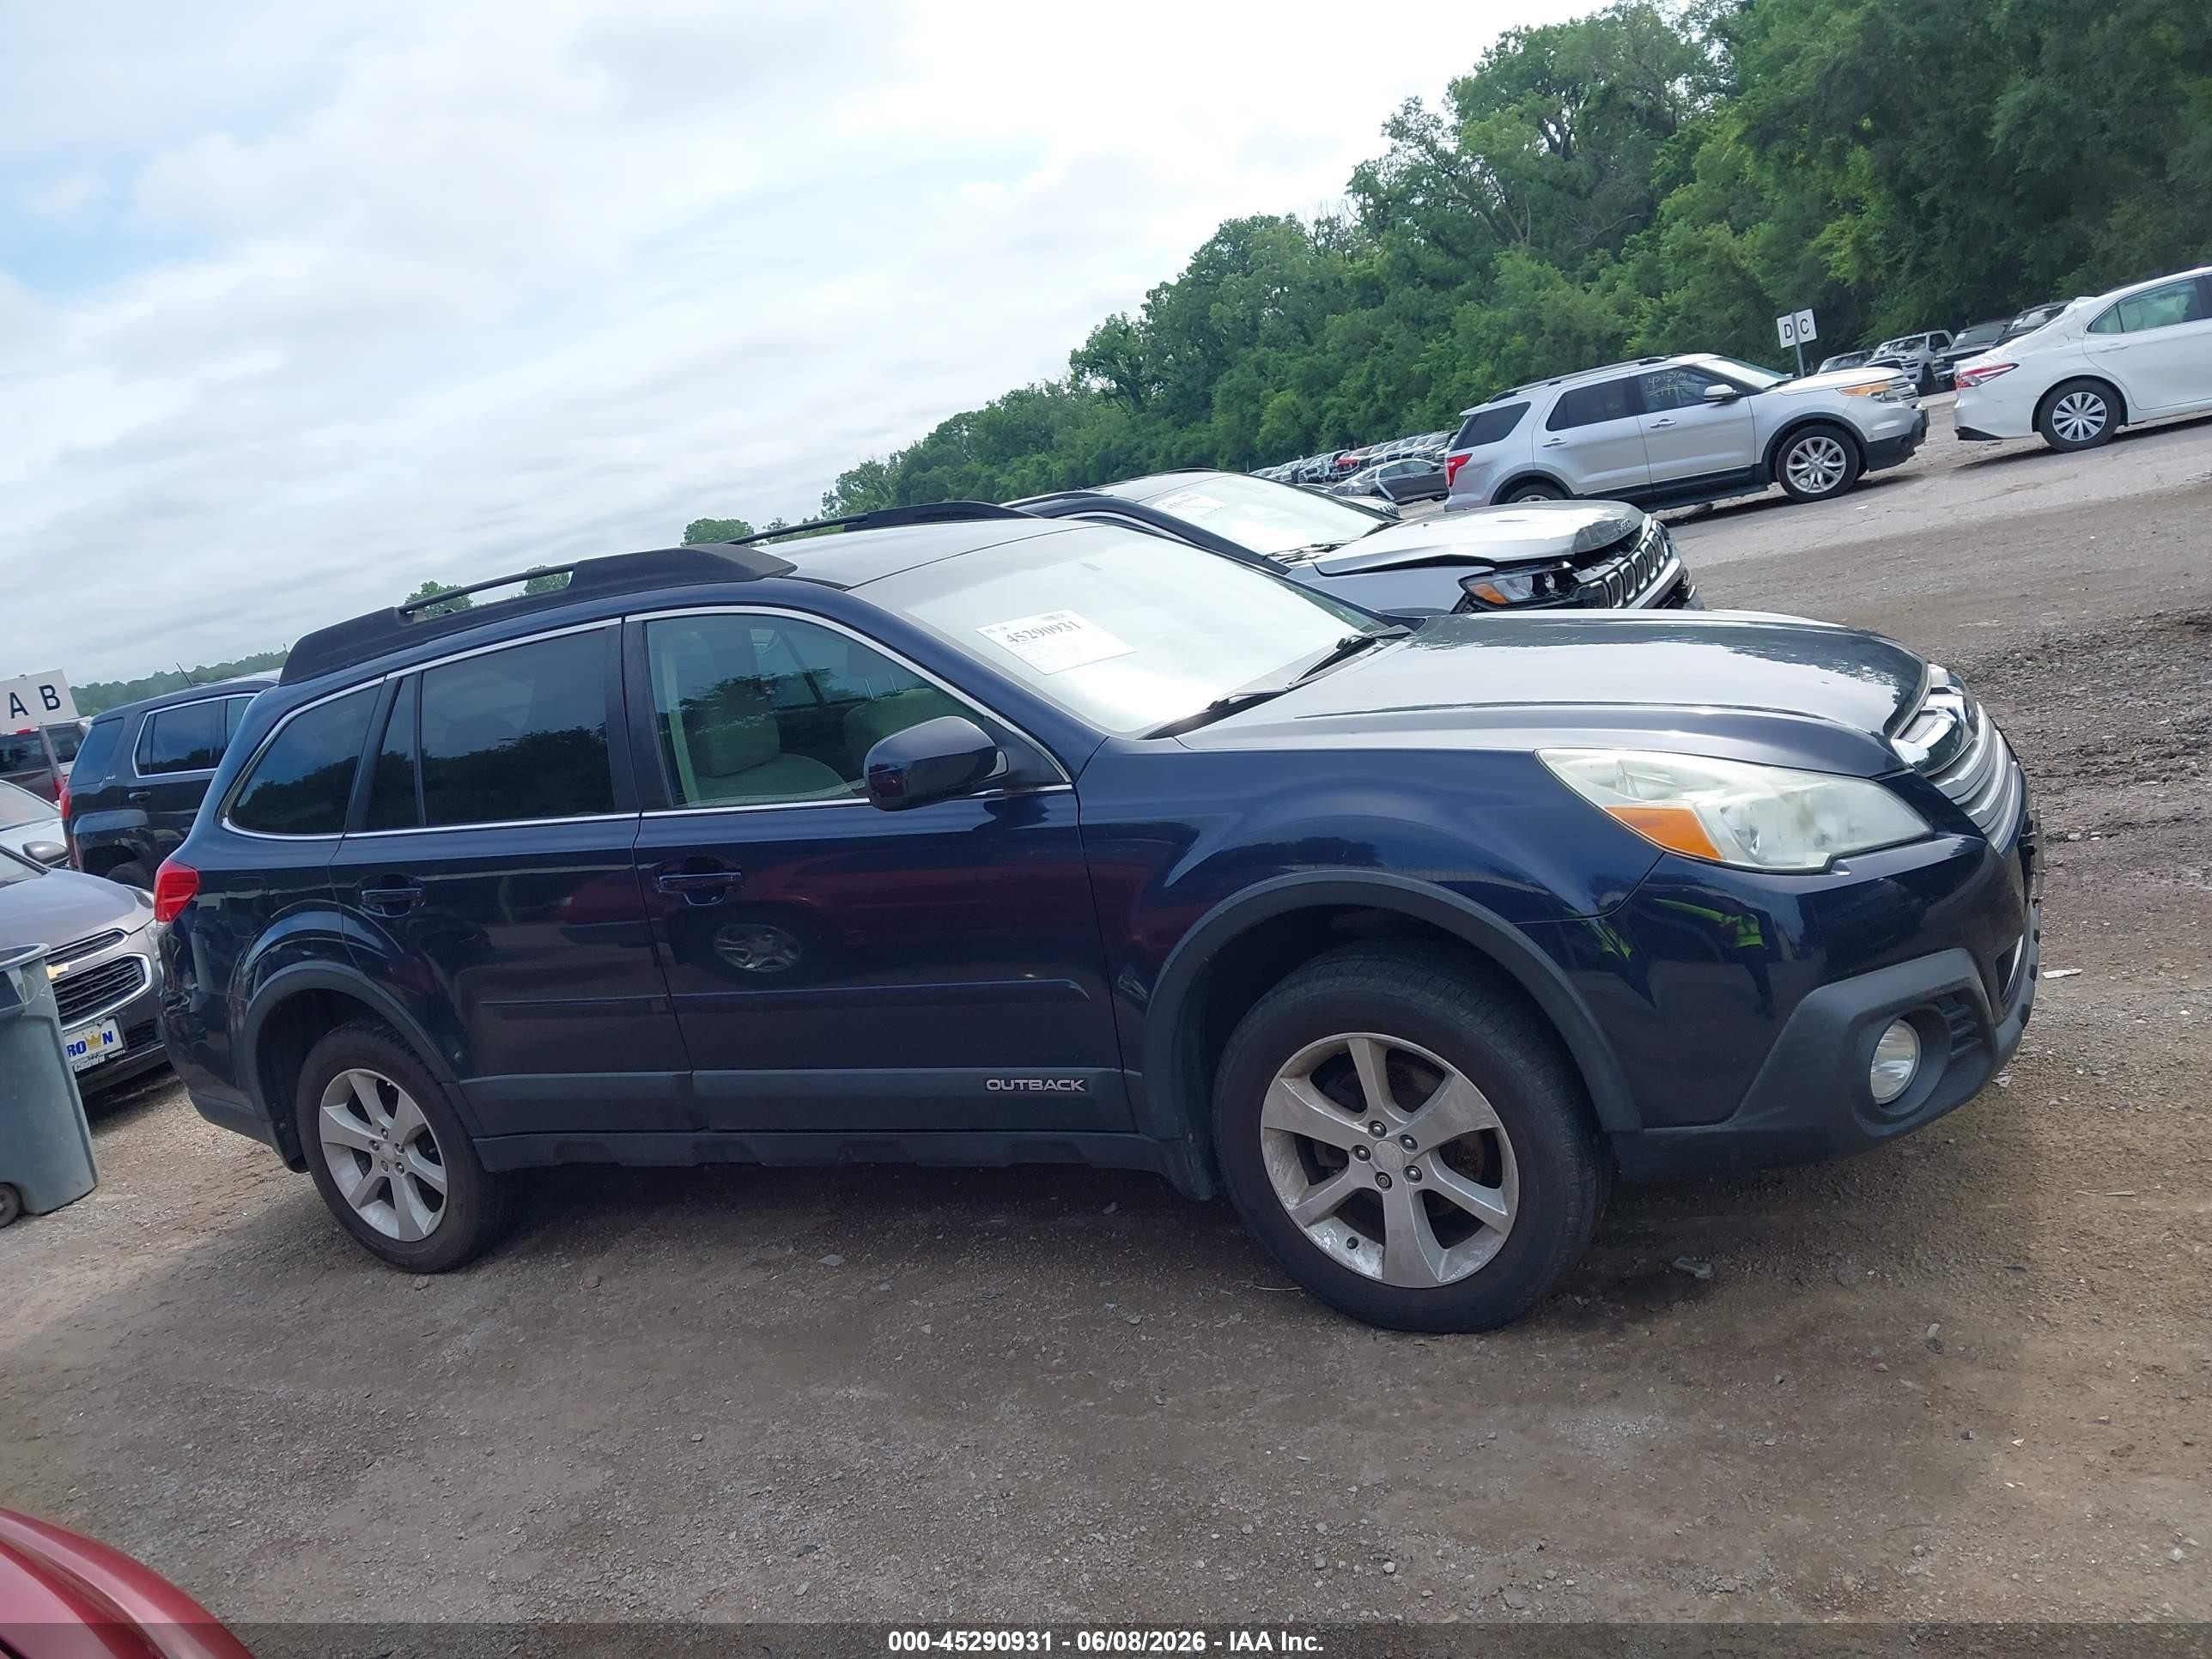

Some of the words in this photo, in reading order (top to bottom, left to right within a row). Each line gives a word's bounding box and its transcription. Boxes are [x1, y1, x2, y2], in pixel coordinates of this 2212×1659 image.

[1784, 323, 1793, 339] D
[1800, 318, 1809, 335] C
[1006, 621, 1082, 643] 45290931
[9, 692, 29, 719] A
[39, 684, 60, 711] B
[986, 1079, 1086, 1091] OUTBACK
